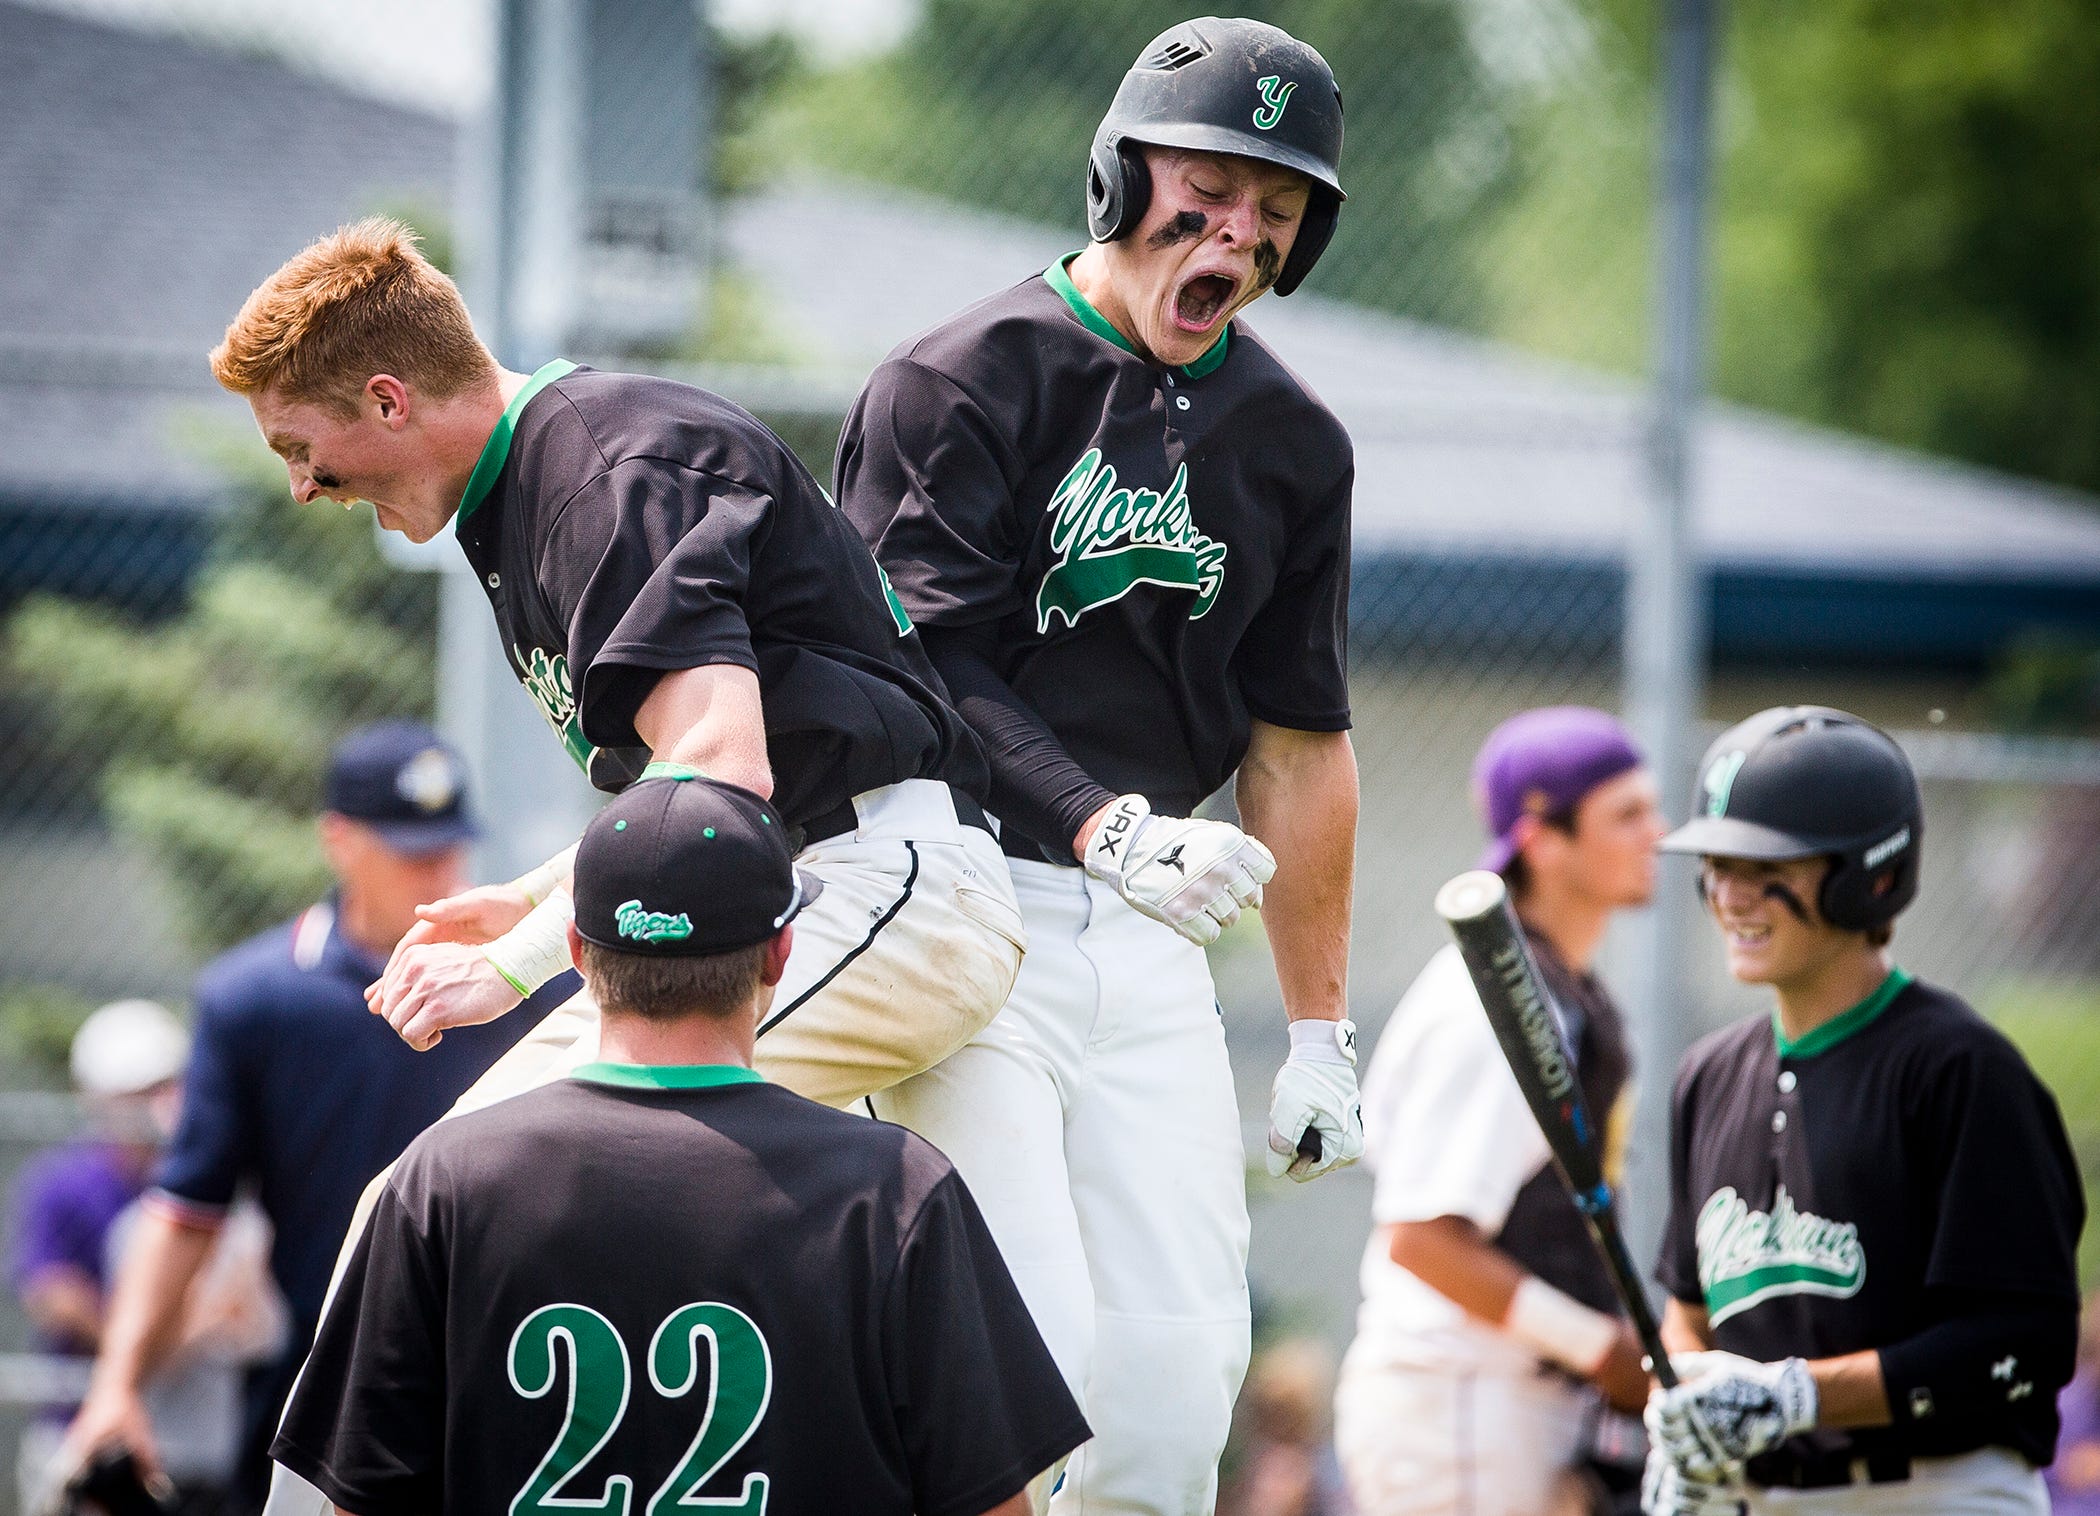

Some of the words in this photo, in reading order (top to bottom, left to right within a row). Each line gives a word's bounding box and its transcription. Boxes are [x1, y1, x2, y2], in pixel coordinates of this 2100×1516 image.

[1252, 75, 1298, 130] Y
[1098, 802, 1138, 857] JAX
[615, 899, 694, 943] Tigers
[506, 1301, 773, 1516] 22
